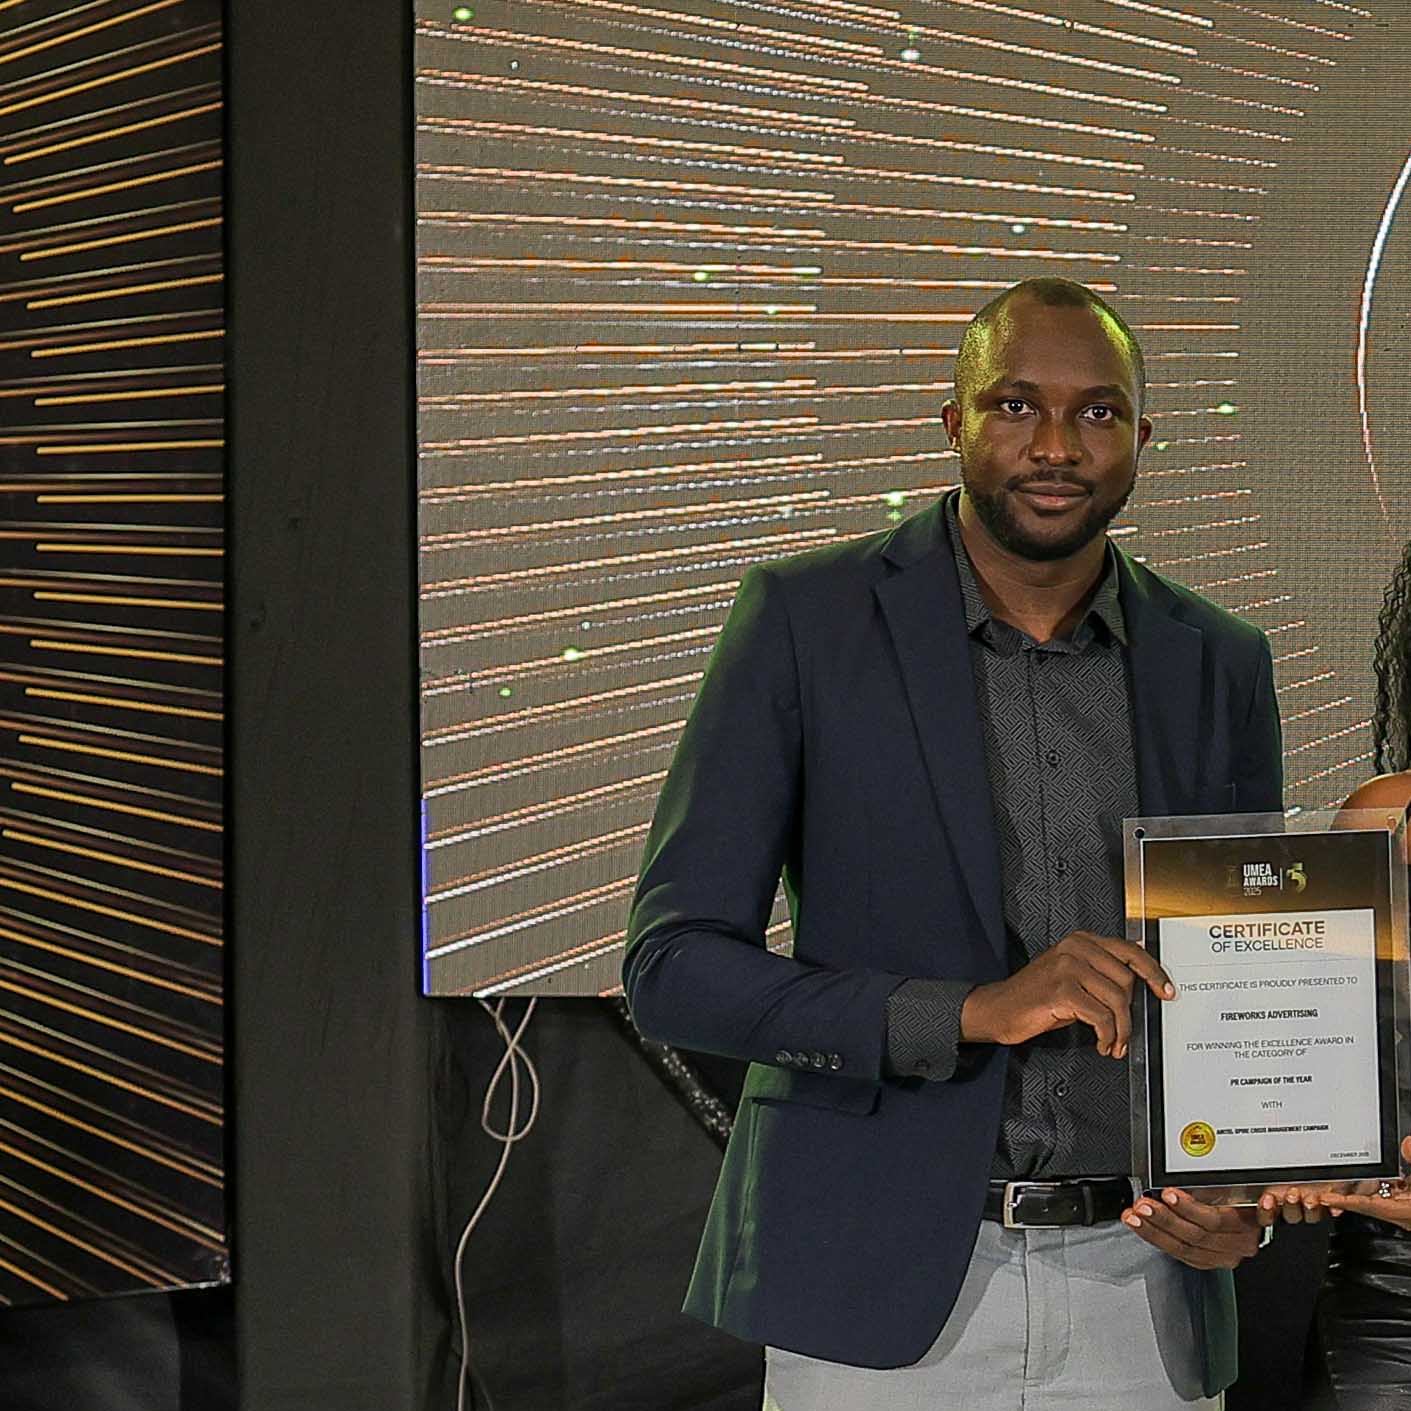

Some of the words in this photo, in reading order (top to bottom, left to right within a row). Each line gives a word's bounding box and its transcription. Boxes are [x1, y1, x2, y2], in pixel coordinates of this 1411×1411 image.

[1243, 863, 1272, 876] UMEA
[1243, 875, 1279, 886] AWARDS
[1209, 920, 1325, 939] CERTIFICATE
[1211, 941, 1231, 952] OF
[1235, 937, 1323, 952] EXCELLENCE
[1179, 983, 1198, 992] THIS
[1199, 981, 1248, 991] CERTIFICATE
[1260, 979, 1296, 988] PROUDLY
[1298, 977, 1345, 986] PRESENTED
[1346, 976, 1358, 984] TO
[1221, 1011, 1266, 1020] FIREWORKS
[1267, 1008, 1318, 1019] ADVERTISING
[1186, 1042, 1203, 1050] FOR
[1205, 1041, 1242, 1050] WINNING
[1244, 1040, 1259, 1048] THE
[1261, 1038, 1312, 1047] EXCELLENCE
[1314, 1036, 1344, 1045] AWARD
[1345, 1036, 1354, 1044] IN
[1234, 1050, 1250, 1058] THE
[1252, 1049, 1294, 1058] CATEGORY
[1296, 1048, 1306, 1056] OF
[1240, 1078, 1272, 1086] CAMPAIGN
[1273, 1076, 1281, 1084] OF
[1283, 1076, 1294, 1084] THE
[1261, 1100, 1282, 1109] WITH
